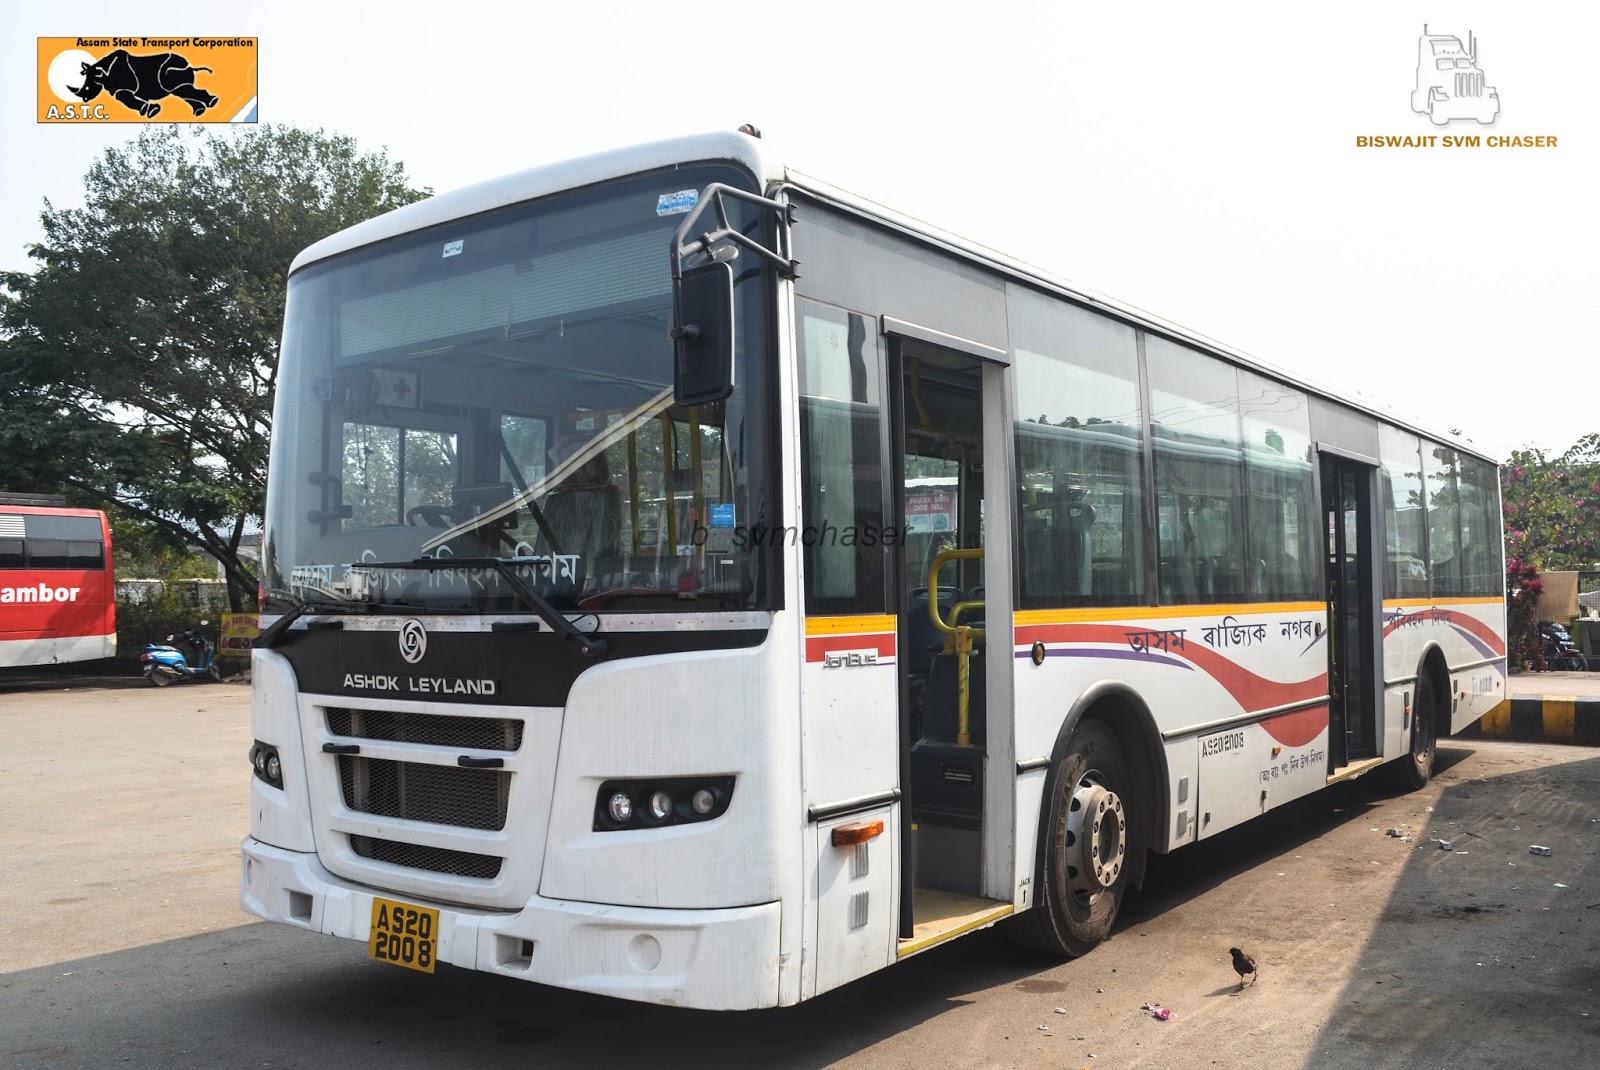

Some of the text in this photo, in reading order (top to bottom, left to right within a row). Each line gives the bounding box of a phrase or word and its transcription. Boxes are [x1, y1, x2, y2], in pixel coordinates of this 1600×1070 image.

[0, 583, 80, 603] ambor
[1124, 629, 1187, 654] অসম
[343, 673, 496, 695] ASHOK LEYLAND
[1019, 877, 1031, 888] JACK
[377, 904, 431, 939] AS20
[375, 931, 431, 967] 2008
